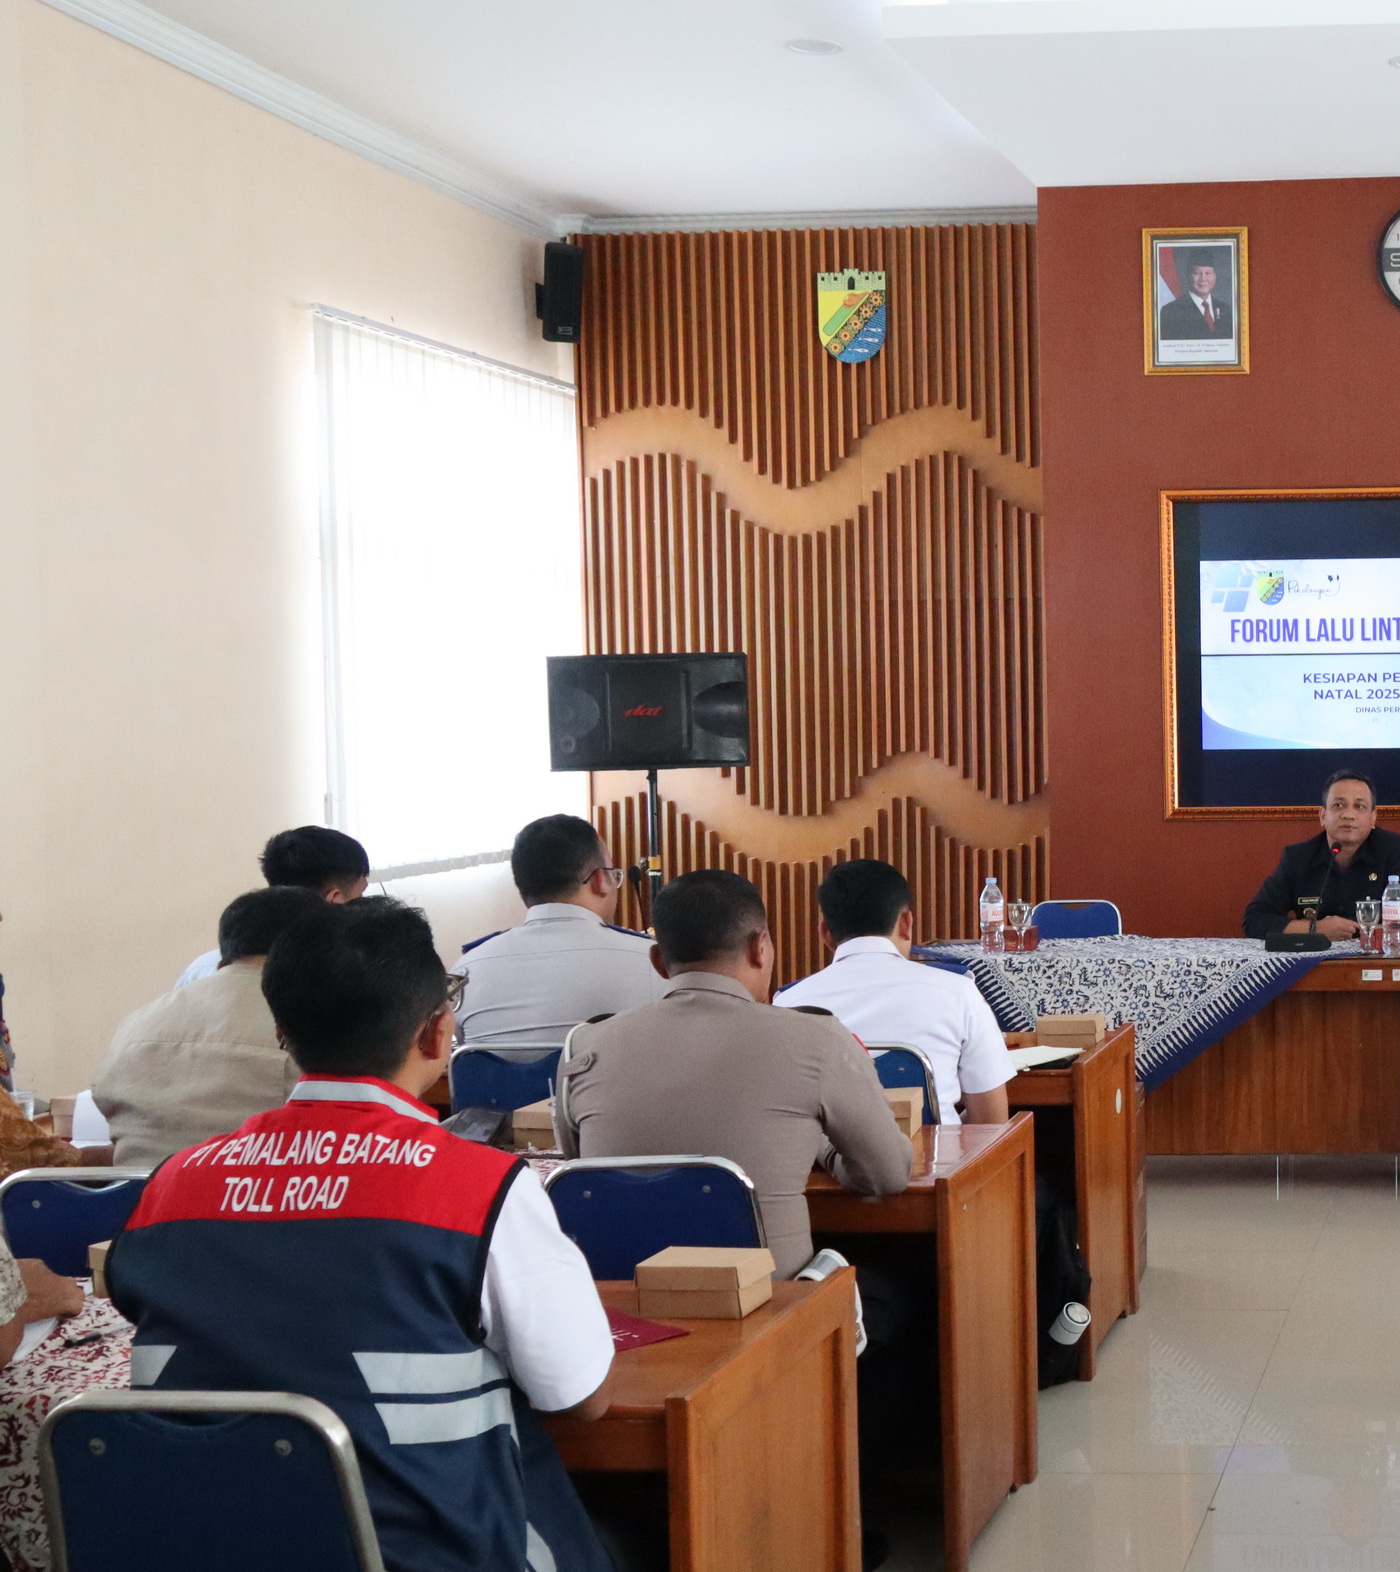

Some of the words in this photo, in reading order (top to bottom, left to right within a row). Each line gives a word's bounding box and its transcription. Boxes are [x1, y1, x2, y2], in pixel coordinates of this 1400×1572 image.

[1230, 618, 1299, 643] FORUM
[1305, 617, 1354, 642] LALU
[1303, 672, 1378, 684] KESIAPAN
[1313, 689, 1362, 700] NATAL
[1366, 688, 1400, 699] 2025
[183, 1141, 222, 1168] PT
[211, 1130, 337, 1166] PEMALANG
[337, 1133, 437, 1168] BATANG
[220, 1177, 275, 1212] TOLL
[281, 1175, 350, 1212] ROAD
